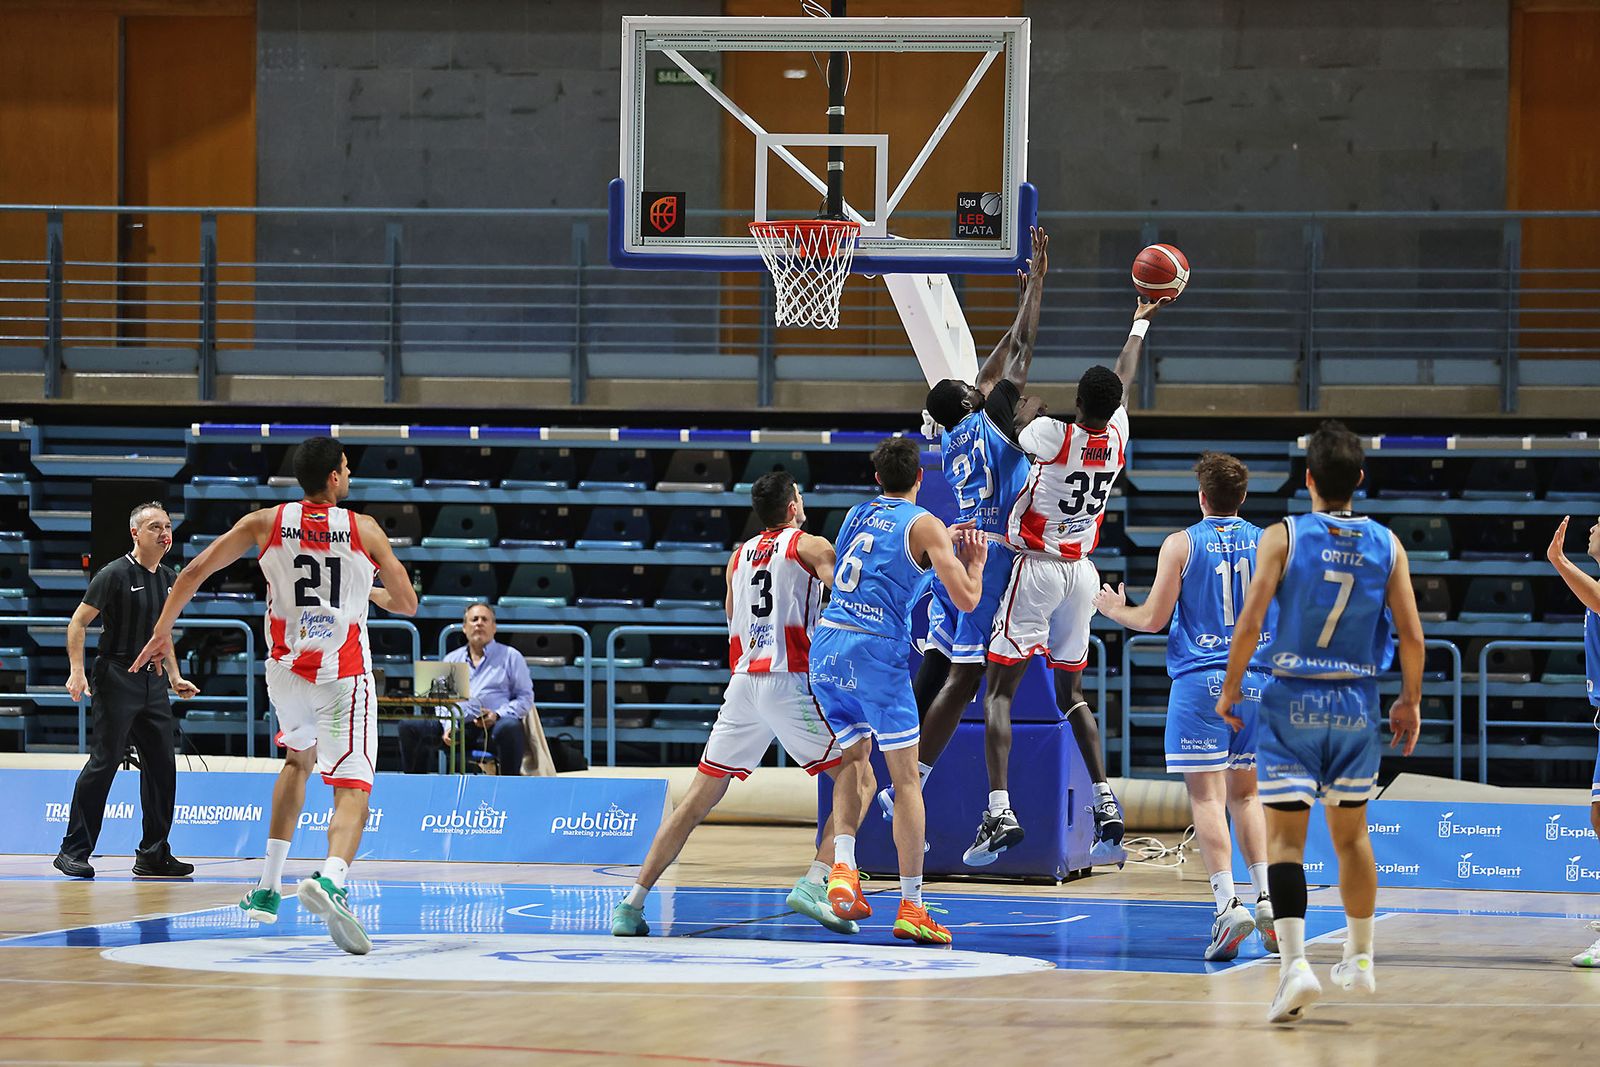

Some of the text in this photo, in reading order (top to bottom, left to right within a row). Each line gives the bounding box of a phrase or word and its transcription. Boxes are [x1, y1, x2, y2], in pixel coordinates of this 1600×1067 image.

[959, 197, 976, 209] Liga
[959, 213, 985, 225] LEB
[958, 225, 994, 235] PLATA
[1080, 447, 1113, 461] THIAM
[952, 438, 994, 510] 23
[1057, 471, 1116, 516] 35
[308, 530, 351, 543] ELERAKY
[1206, 539, 1257, 553] CEBOLLA
[835, 532, 875, 593] 6
[1321, 548, 1365, 567] ORTIZ
[293, 554, 341, 609] 21
[751, 570, 773, 618] 3
[1215, 556, 1251, 627] 11
[1316, 569, 1354, 648] 7
[1306, 658, 1377, 676] HYUNDAI
[1291, 712, 1366, 728] GESTIA
[45, 802, 134, 818] TRAMÁN
[174, 804, 262, 821] TRANSROMÁN
[421, 809, 508, 831] publibit
[551, 811, 638, 833] publibit
[433, 827, 464, 835] marketing
[471, 827, 503, 835] publicidad
[563, 829, 594, 837] marketing
[1367, 823, 1400, 834] plant
[1453, 824, 1502, 836] Explant
[1560, 827, 1597, 838] Expla
[1472, 866, 1521, 876] Explant
